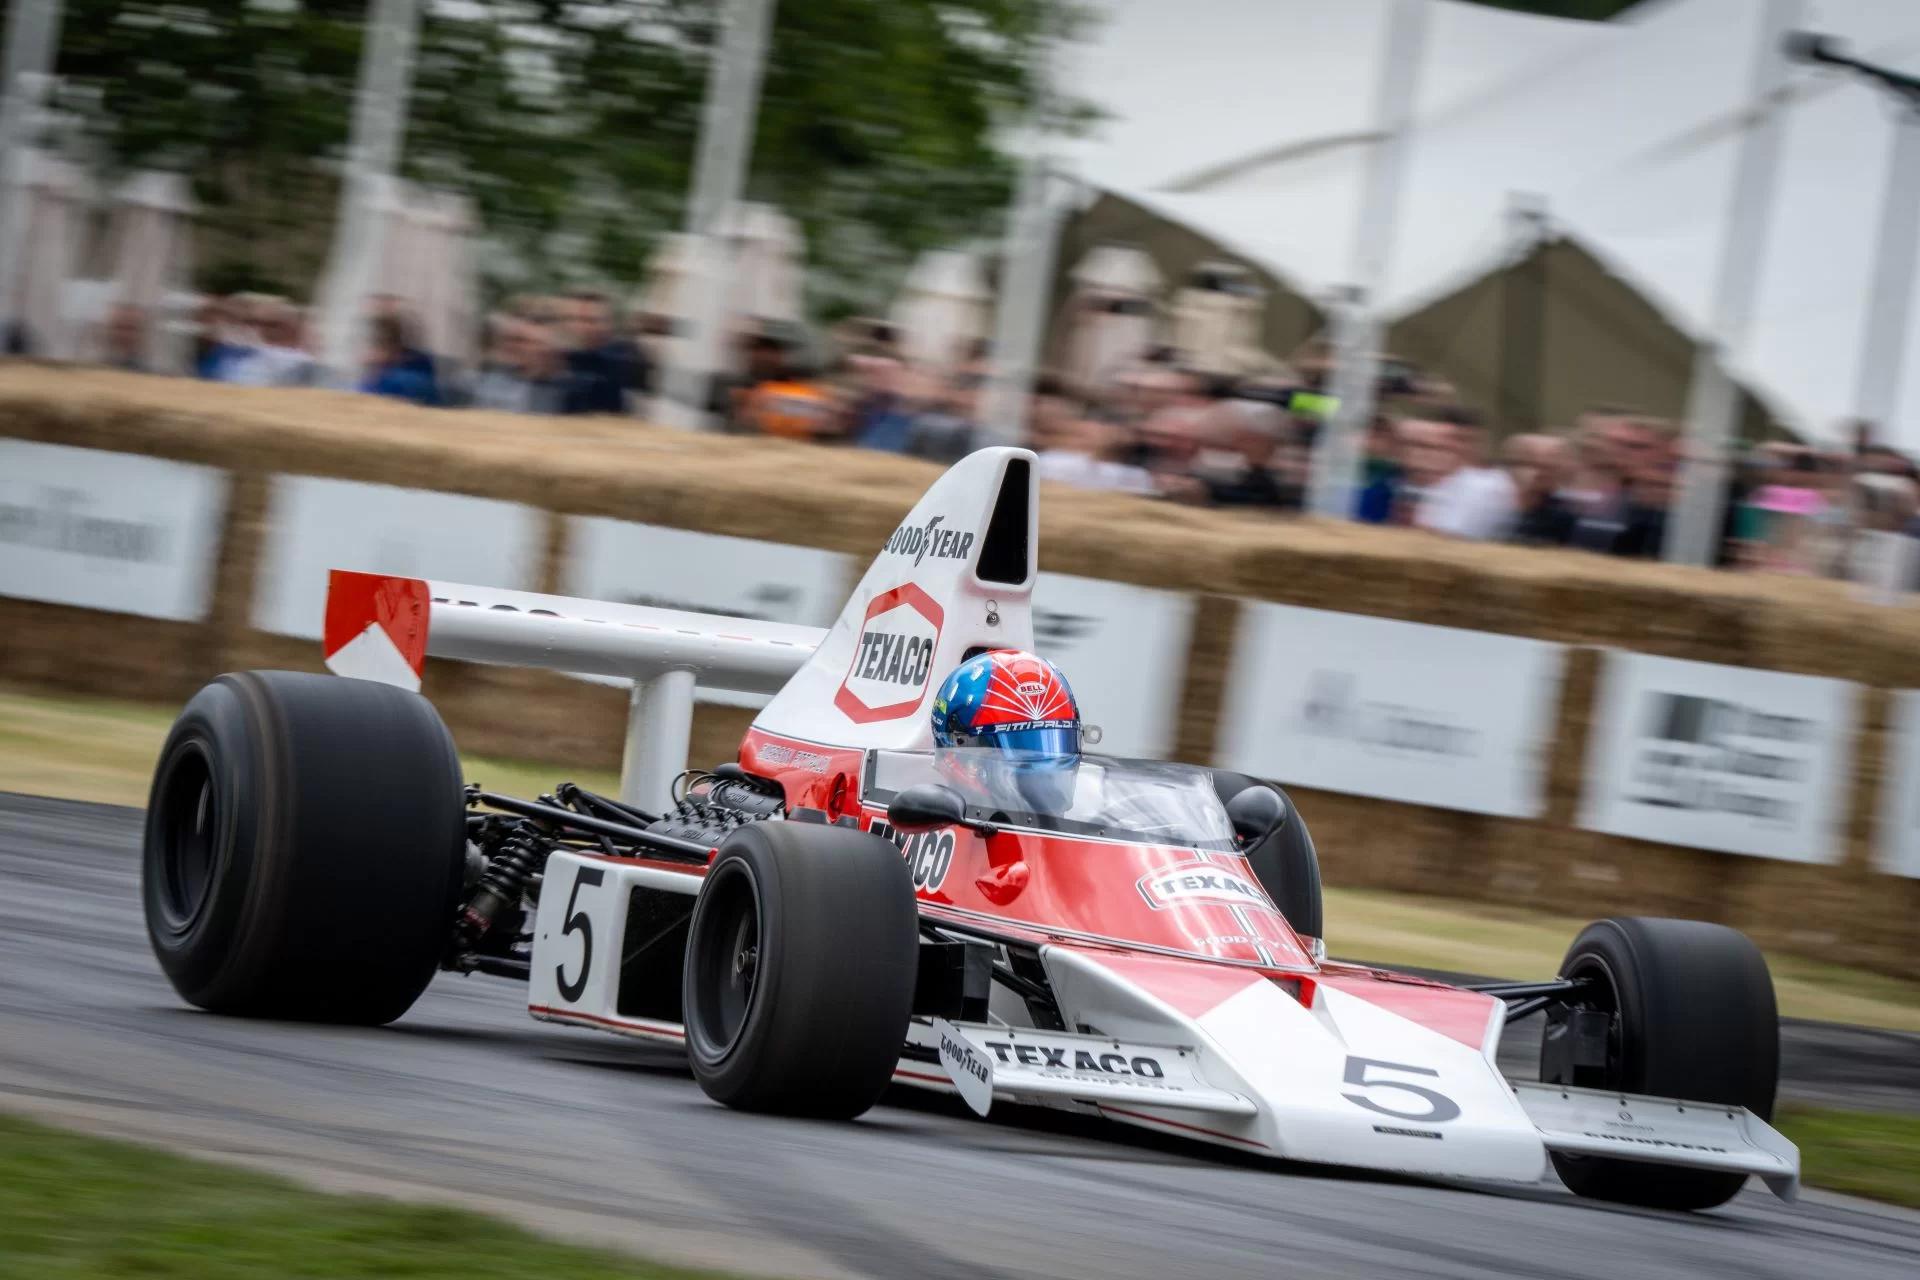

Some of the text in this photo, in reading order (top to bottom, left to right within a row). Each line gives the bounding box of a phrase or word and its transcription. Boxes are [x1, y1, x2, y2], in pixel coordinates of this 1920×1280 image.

[854, 632, 933, 686] TEXACO
[1020, 684, 1043, 693] BELL
[994, 721, 1073, 733] FITTIPALDI
[556, 866, 605, 1003] 5
[985, 1041, 1164, 1078] TEXACO
[1341, 1055, 1461, 1122] 5
